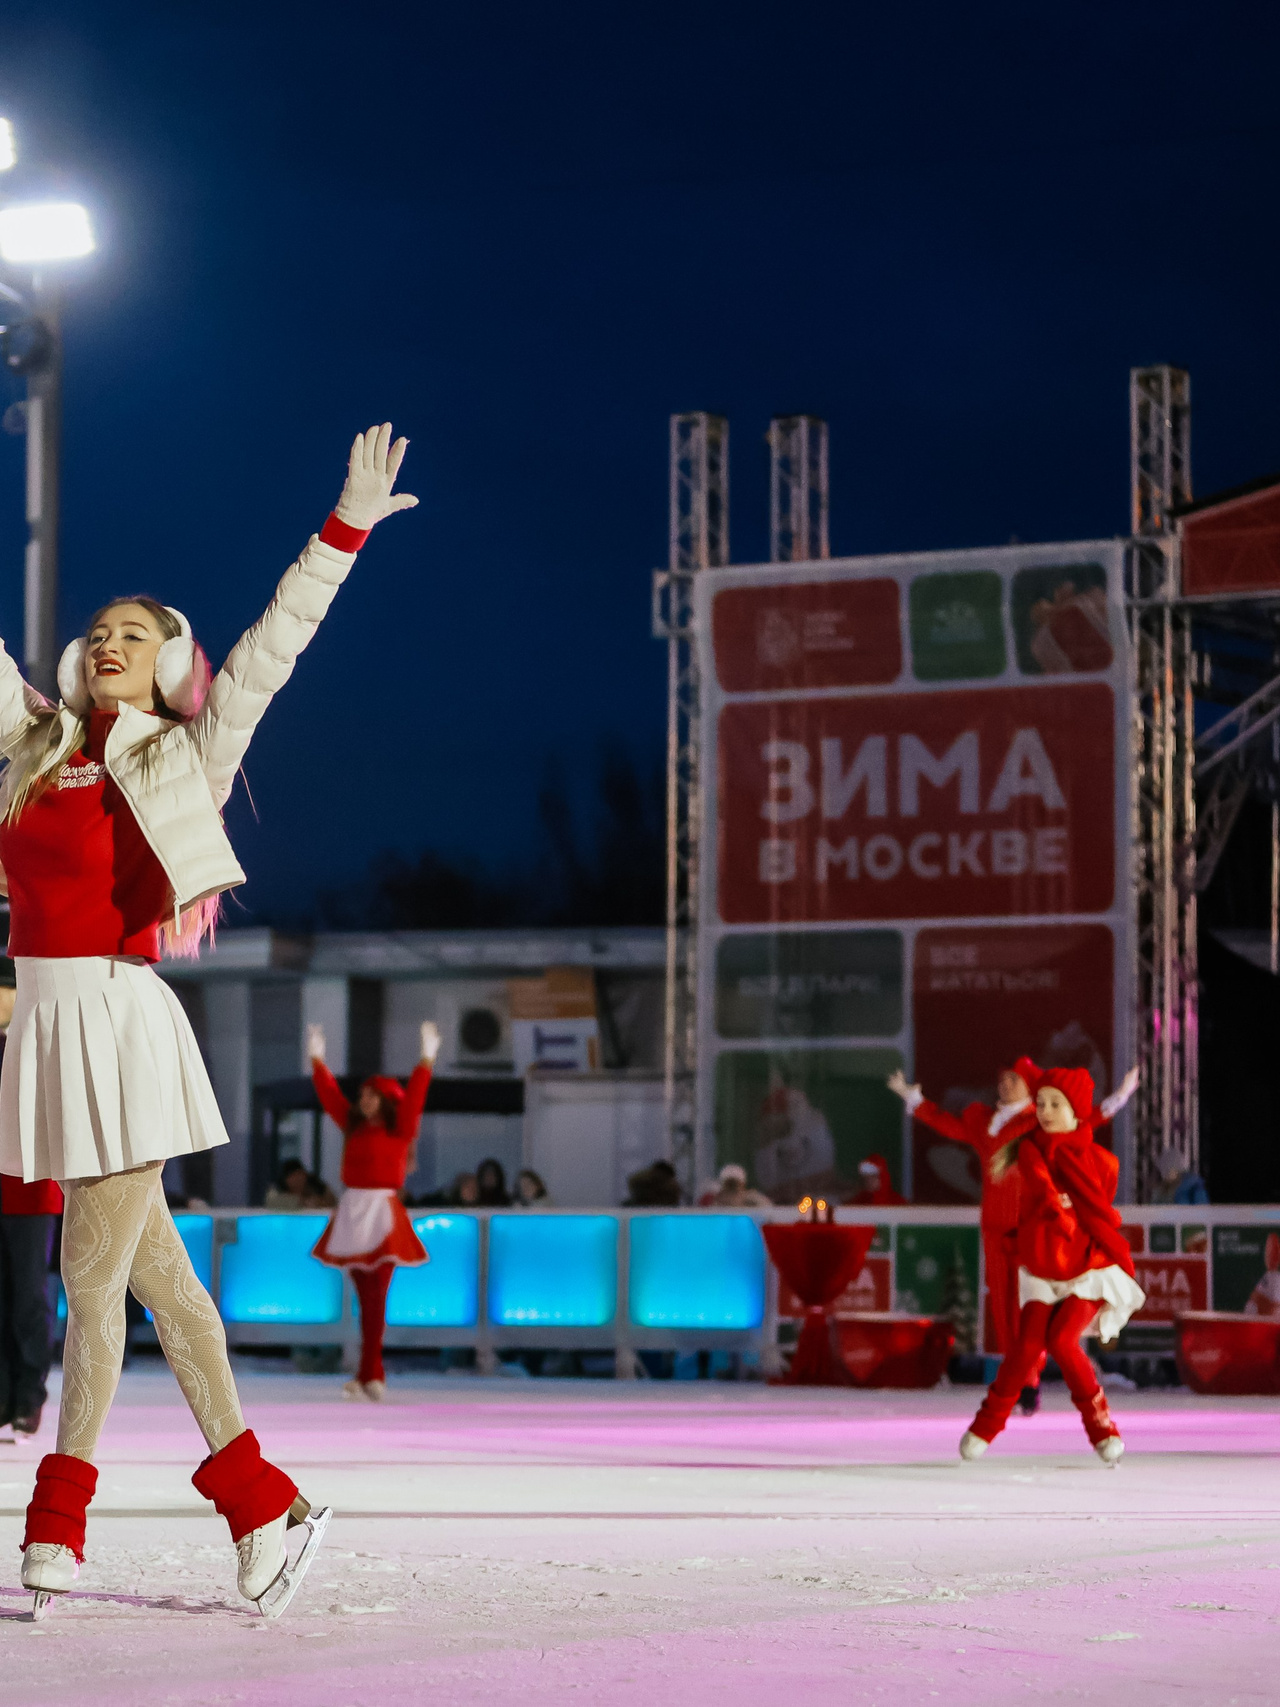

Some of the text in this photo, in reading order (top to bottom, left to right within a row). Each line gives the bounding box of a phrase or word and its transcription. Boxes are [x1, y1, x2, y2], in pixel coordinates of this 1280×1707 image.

[760, 727, 1067, 823] ЗИМА
[758, 827, 1068, 884] В МОСКВЕ
